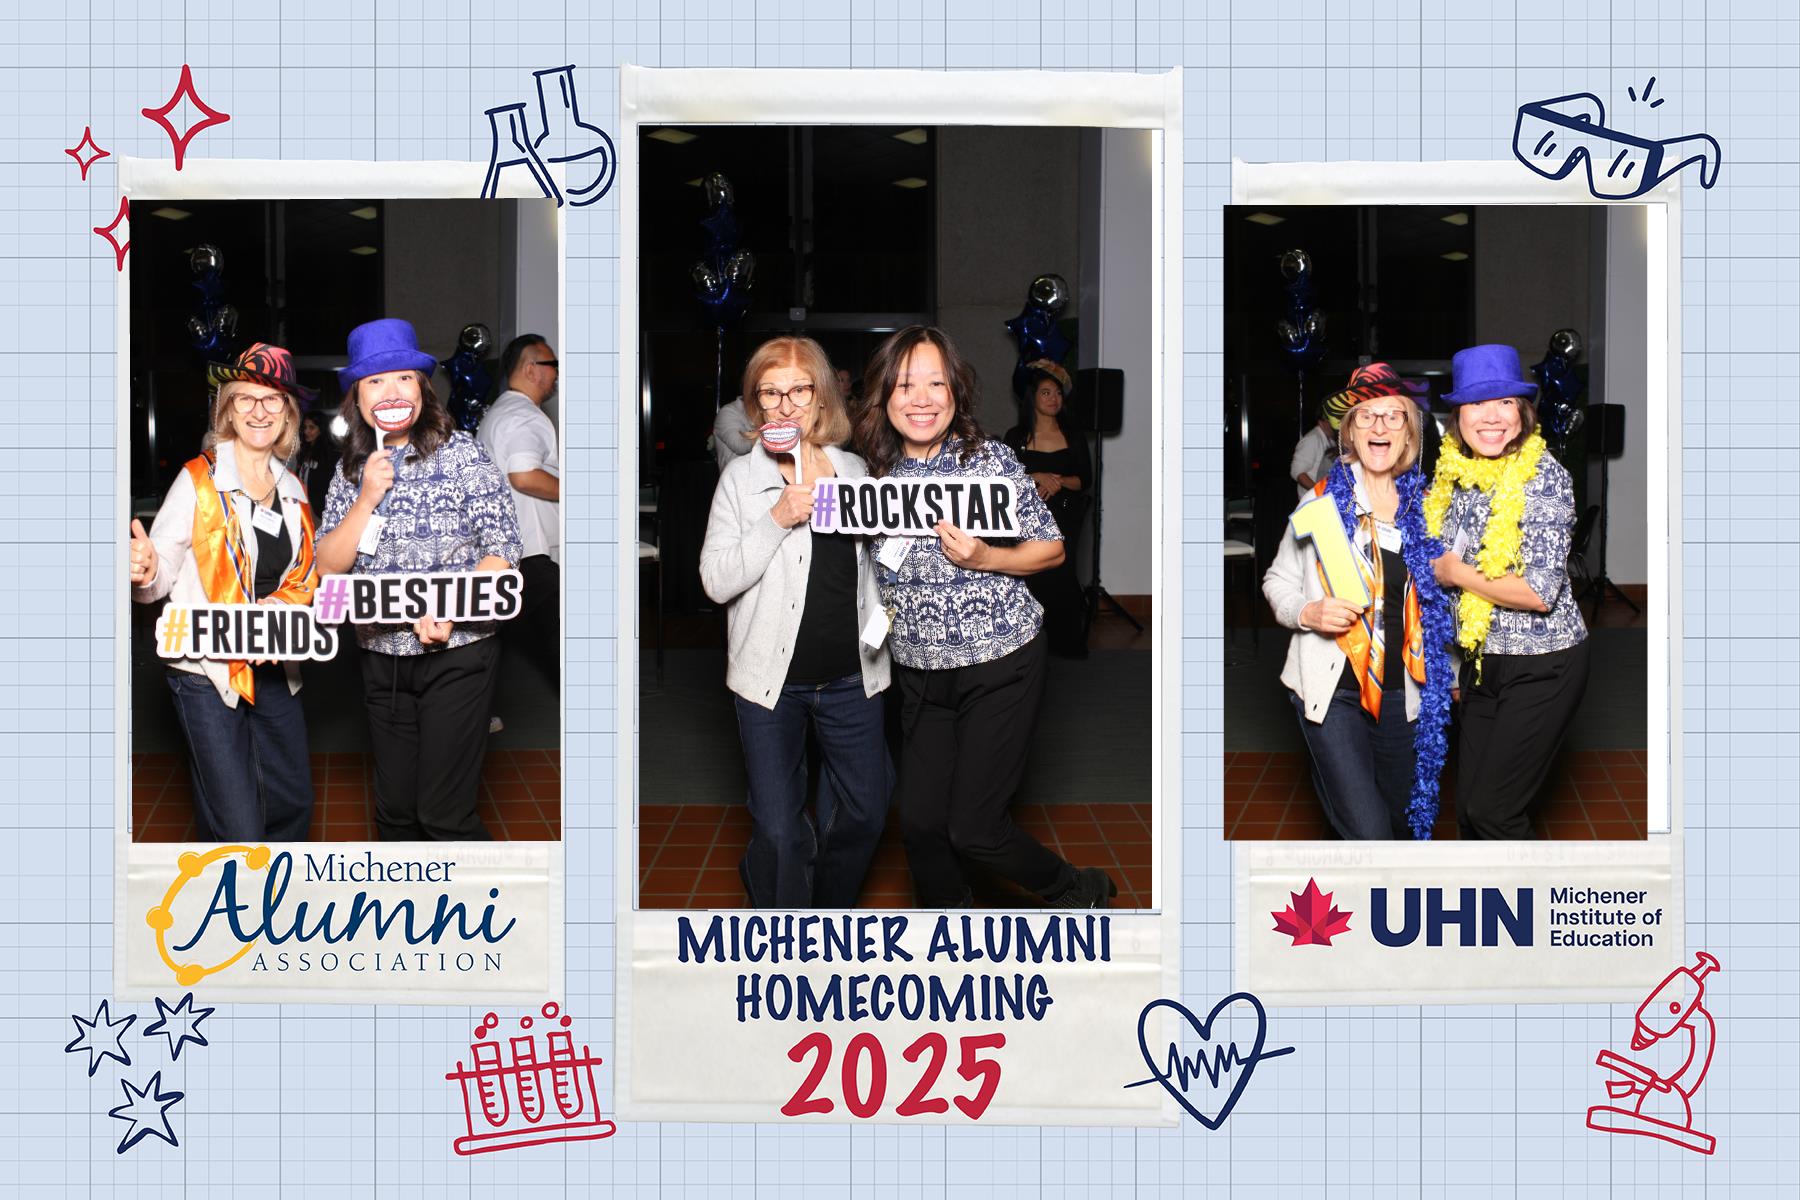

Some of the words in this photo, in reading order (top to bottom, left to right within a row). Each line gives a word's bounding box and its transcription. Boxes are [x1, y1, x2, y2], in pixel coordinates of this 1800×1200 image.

[814, 483, 1014, 531] #ROCKSTAR
[319, 574, 518, 620] #BESTIES
[163, 609, 333, 656] #FRIENDS
